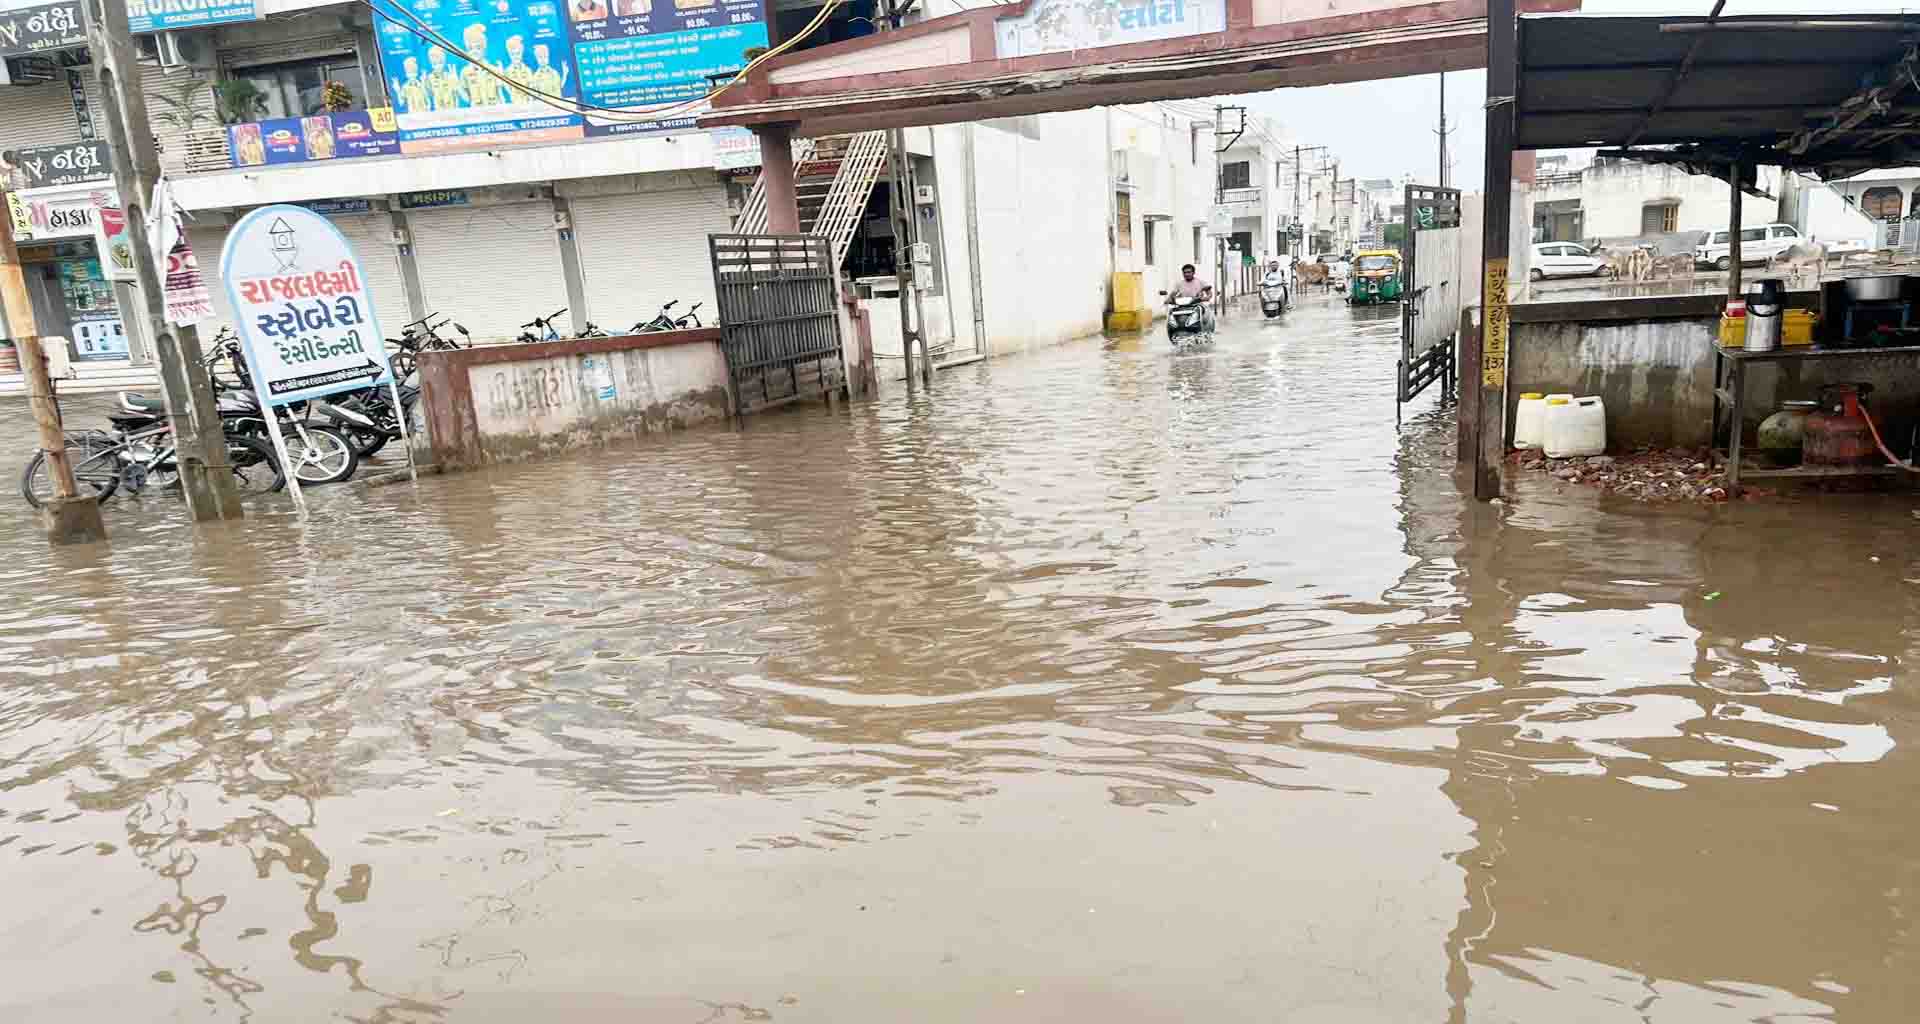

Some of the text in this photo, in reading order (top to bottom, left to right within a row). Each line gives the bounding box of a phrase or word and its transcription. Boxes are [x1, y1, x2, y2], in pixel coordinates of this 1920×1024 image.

[240, 260, 360, 304] રાજલક્ષ્મી
[257, 295, 364, 340] સ્ટ્રોબેરી
[273, 329, 365, 365] રેસીડેન્સી
